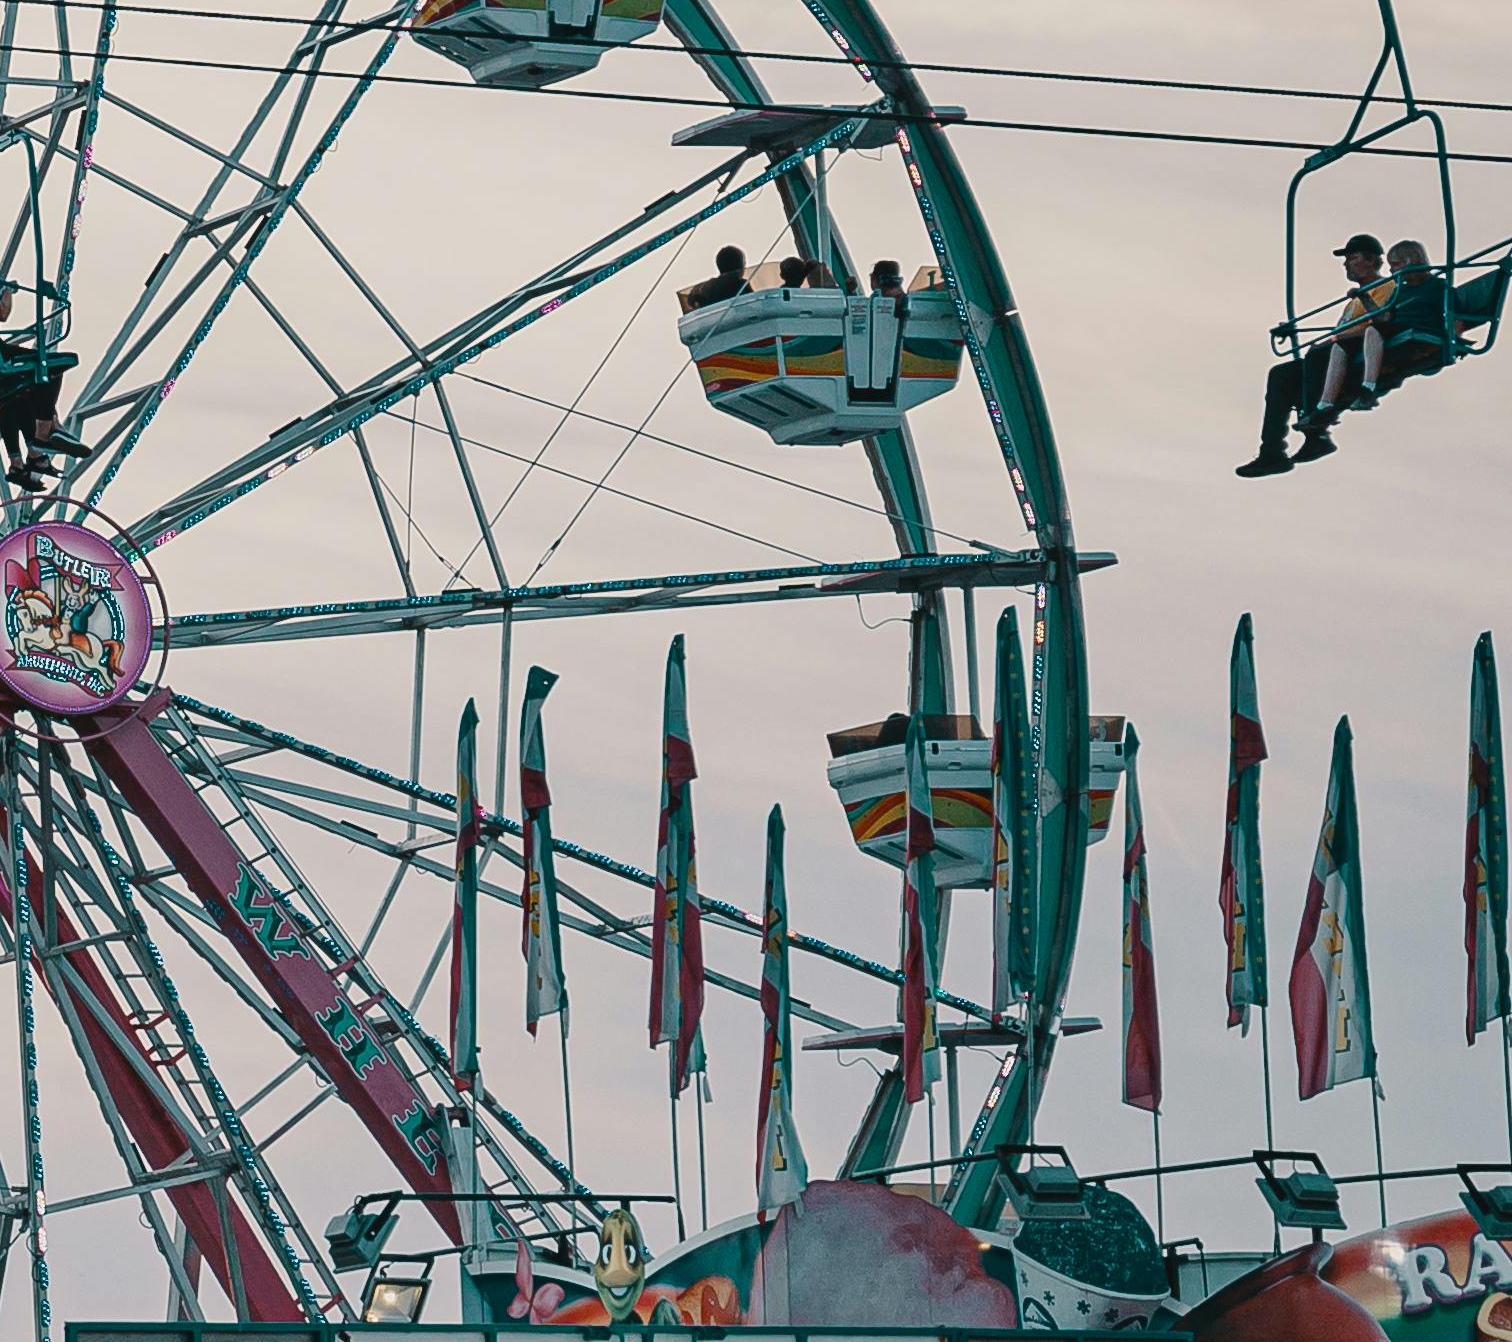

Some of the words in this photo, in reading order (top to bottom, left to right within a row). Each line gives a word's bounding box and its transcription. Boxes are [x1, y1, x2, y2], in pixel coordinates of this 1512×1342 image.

[36, 535, 112, 588] BUTLER
[227, 862, 448, 1177] WHE
[1403, 1233, 1512, 1311] RA
